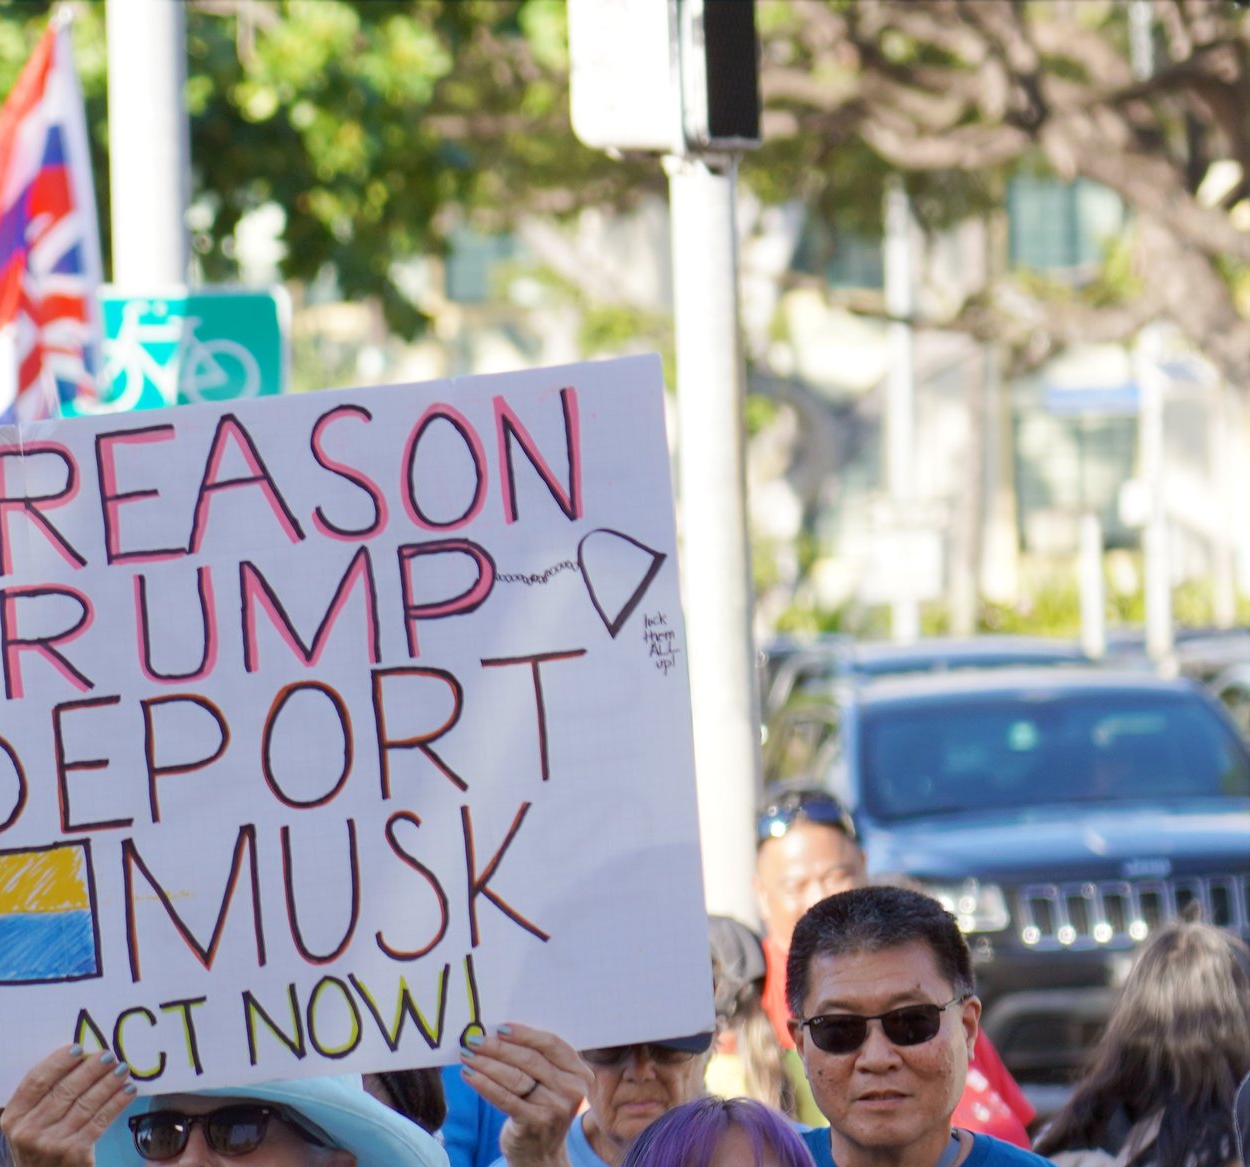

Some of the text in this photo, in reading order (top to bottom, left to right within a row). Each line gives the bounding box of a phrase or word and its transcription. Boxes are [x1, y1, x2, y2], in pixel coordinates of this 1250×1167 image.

[650, 641, 681, 657] ALL
[121, 801, 550, 982] MUSK
[73, 954, 488, 1080] ACT NOW!
